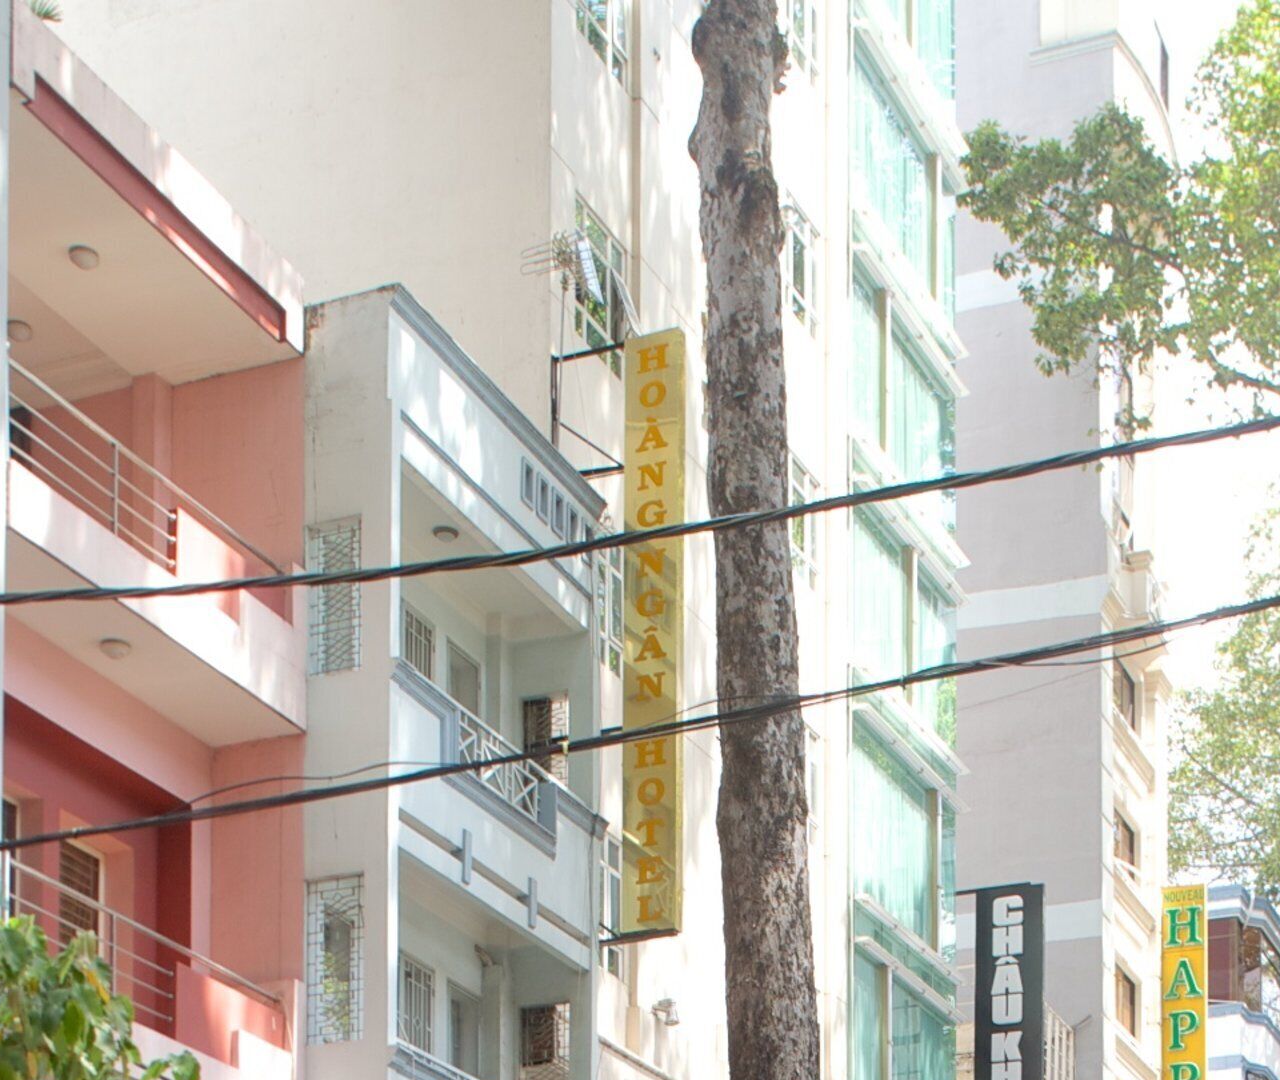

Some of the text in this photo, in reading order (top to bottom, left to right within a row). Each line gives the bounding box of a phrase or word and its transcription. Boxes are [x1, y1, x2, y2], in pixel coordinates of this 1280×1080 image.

[633, 343, 670, 924] HOÀNG NGÂN HOTEL
[989, 894, 1024, 1026] CHÂU
